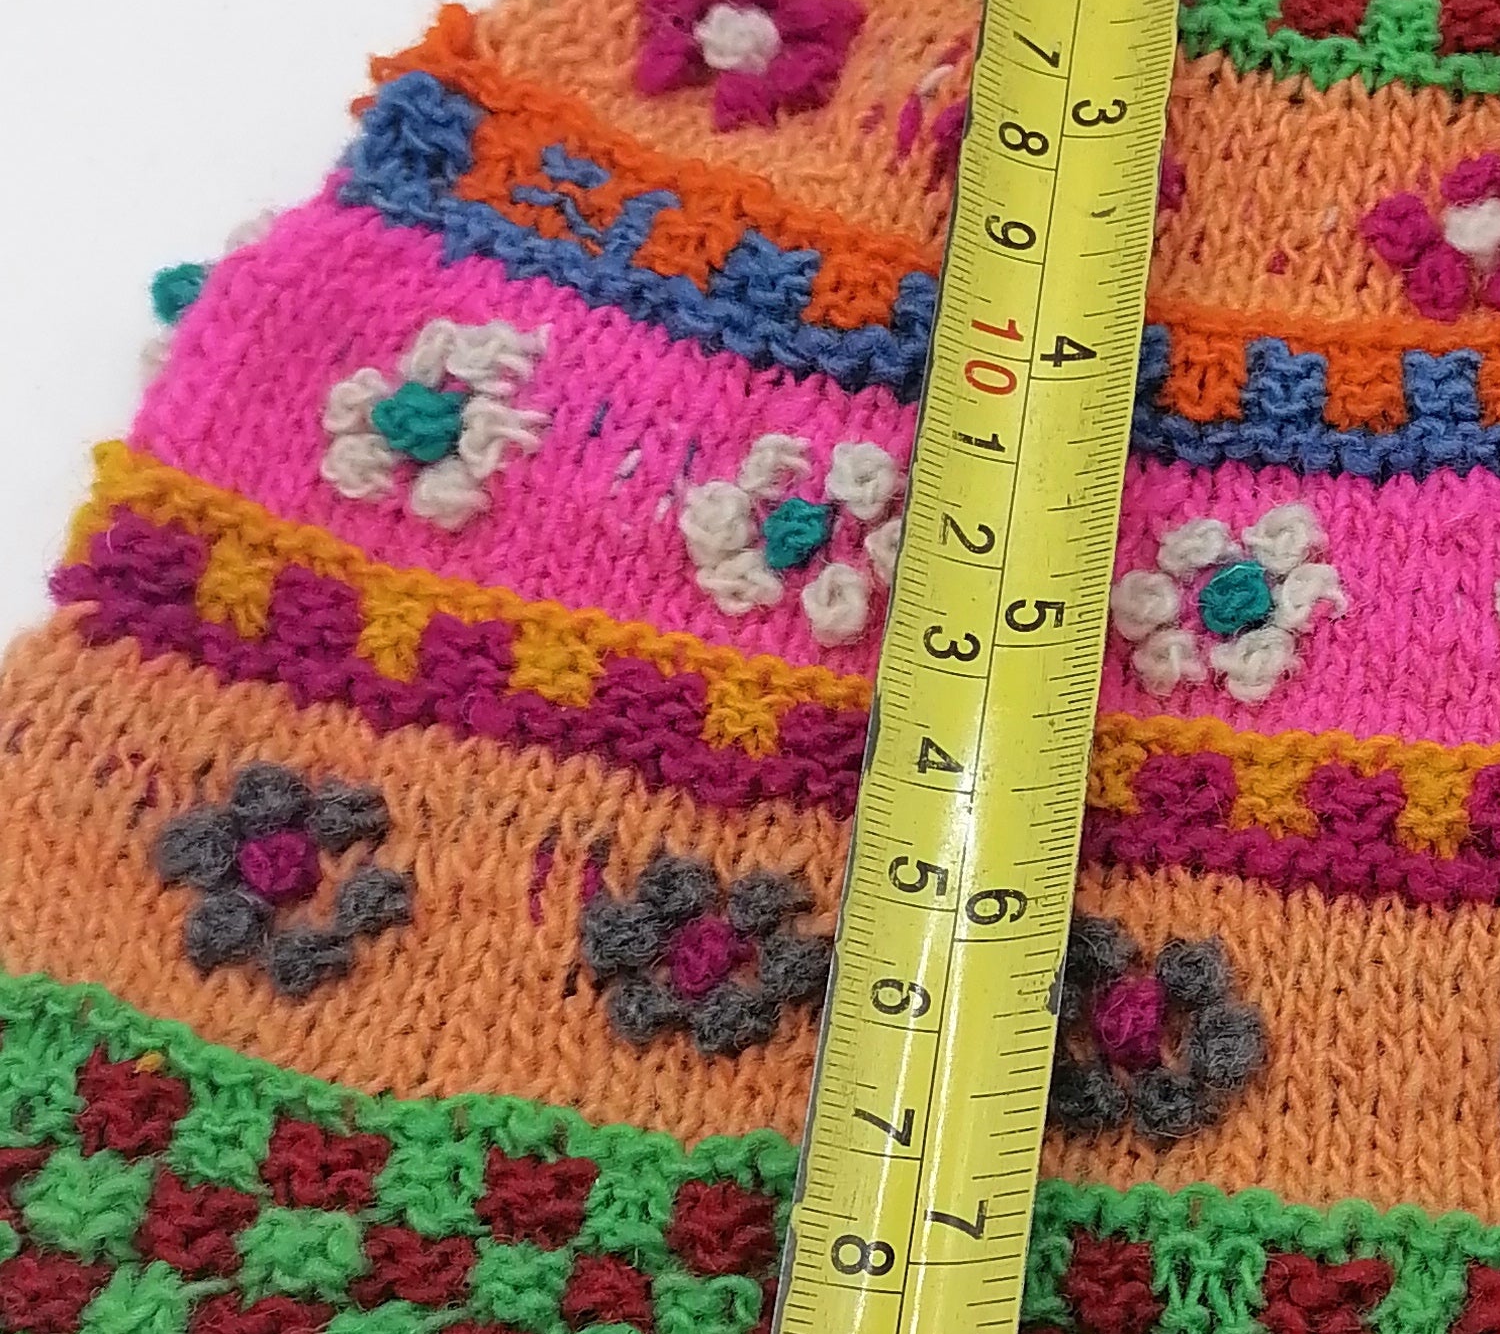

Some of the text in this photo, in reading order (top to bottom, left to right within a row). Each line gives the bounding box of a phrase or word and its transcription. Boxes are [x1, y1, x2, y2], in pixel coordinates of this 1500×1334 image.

[1013, 30, 1062, 68] 7
[1071, 98, 1127, 127] 3
[998, 121, 1050, 157] 8
[984, 214, 1037, 251] 9
[964, 318, 1025, 395] 10
[1039, 335, 1097, 368] 4
[952, 430, 1006, 453] 1
[939, 512, 996, 555] 2
[1004, 599, 1066, 633] 5
[923, 625, 981, 662] 3
[917, 736, 966, 774] 4
[888, 855, 949, 897] 5
[965, 888, 1028, 926] 6
[871, 978, 931, 1018] 6
[851, 1107, 916, 1147] 7
[923, 1199, 988, 1241] 7
[830, 1233, 895, 1277] 8
